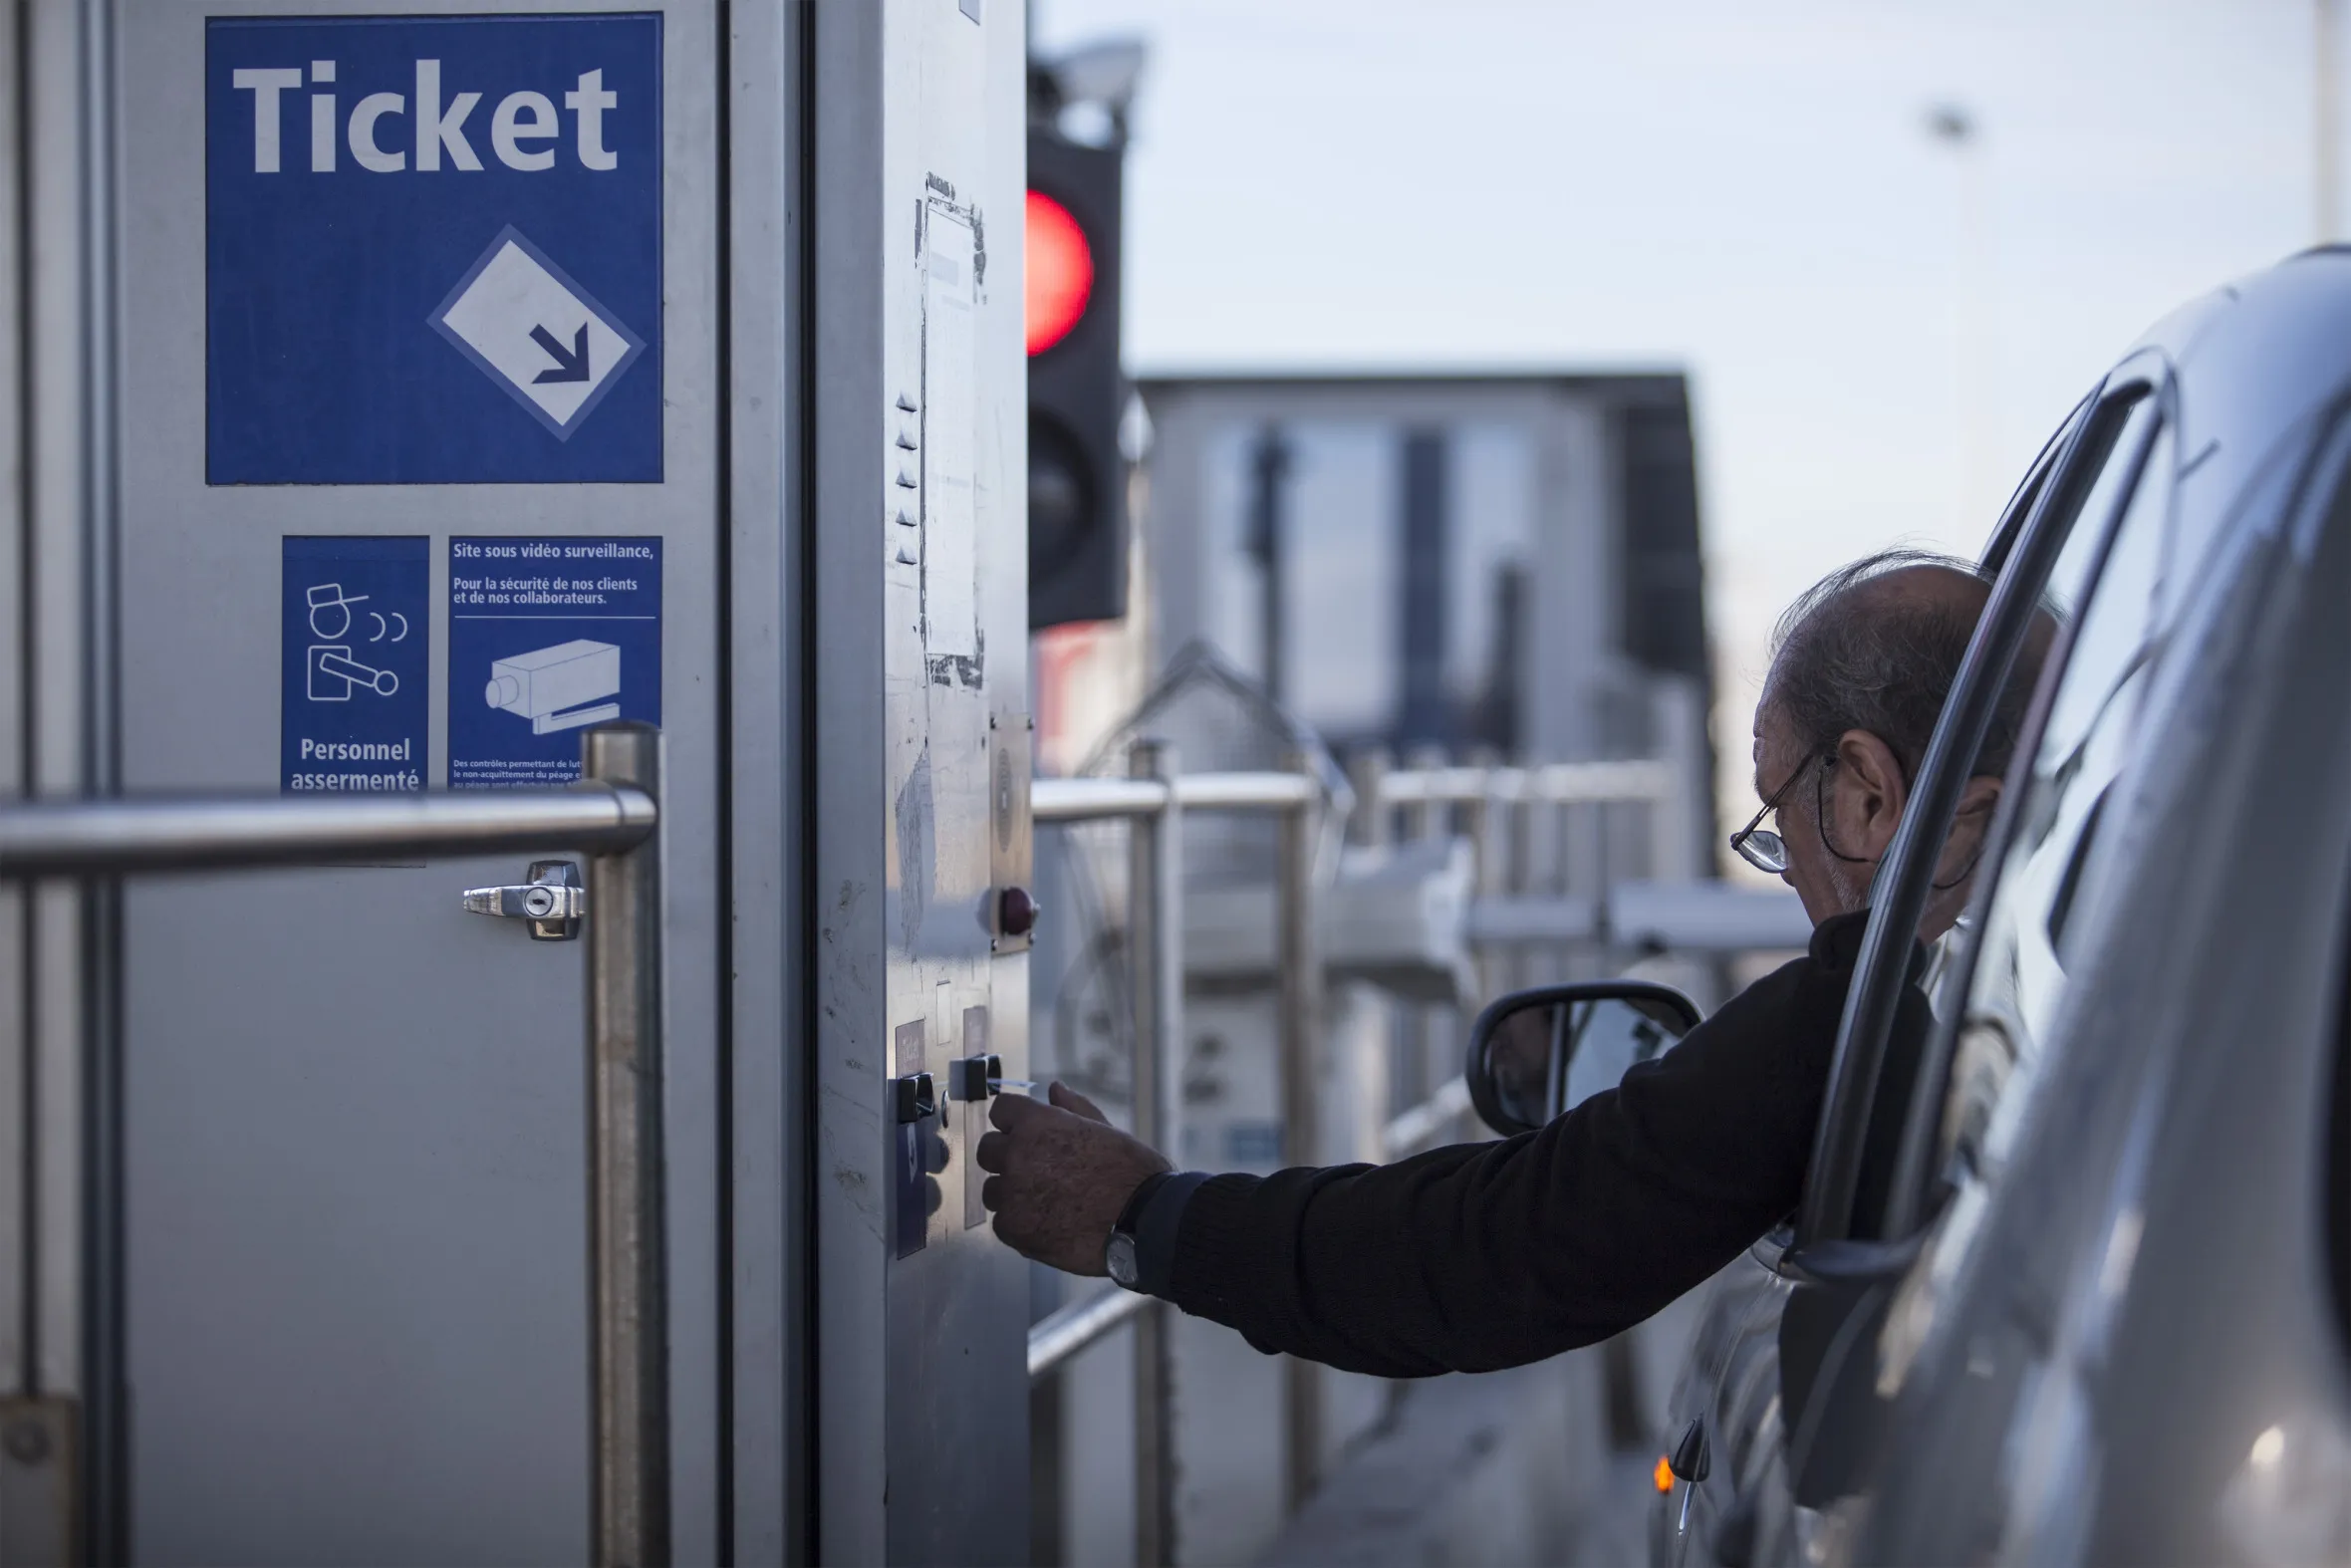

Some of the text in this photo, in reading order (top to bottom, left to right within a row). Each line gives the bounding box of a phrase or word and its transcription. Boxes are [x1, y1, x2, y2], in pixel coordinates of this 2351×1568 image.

[233, 59, 618, 173] Ticket
[453, 543, 654, 561] Site sous vidéo surveillance,
[453, 577, 638, 591] Pour la sécurité de nos clients
[453, 591, 608, 605] et de nos collaborateurs.
[301, 737, 410, 760] Personnel
[453, 759, 468, 768] Des
[469, 759, 507, 768] contrôles
[508, 760, 555, 769] permettant
[291, 768, 419, 792] assermenté
[462, 770, 534, 779] non-acquittement
[548, 771, 574, 780] péage
